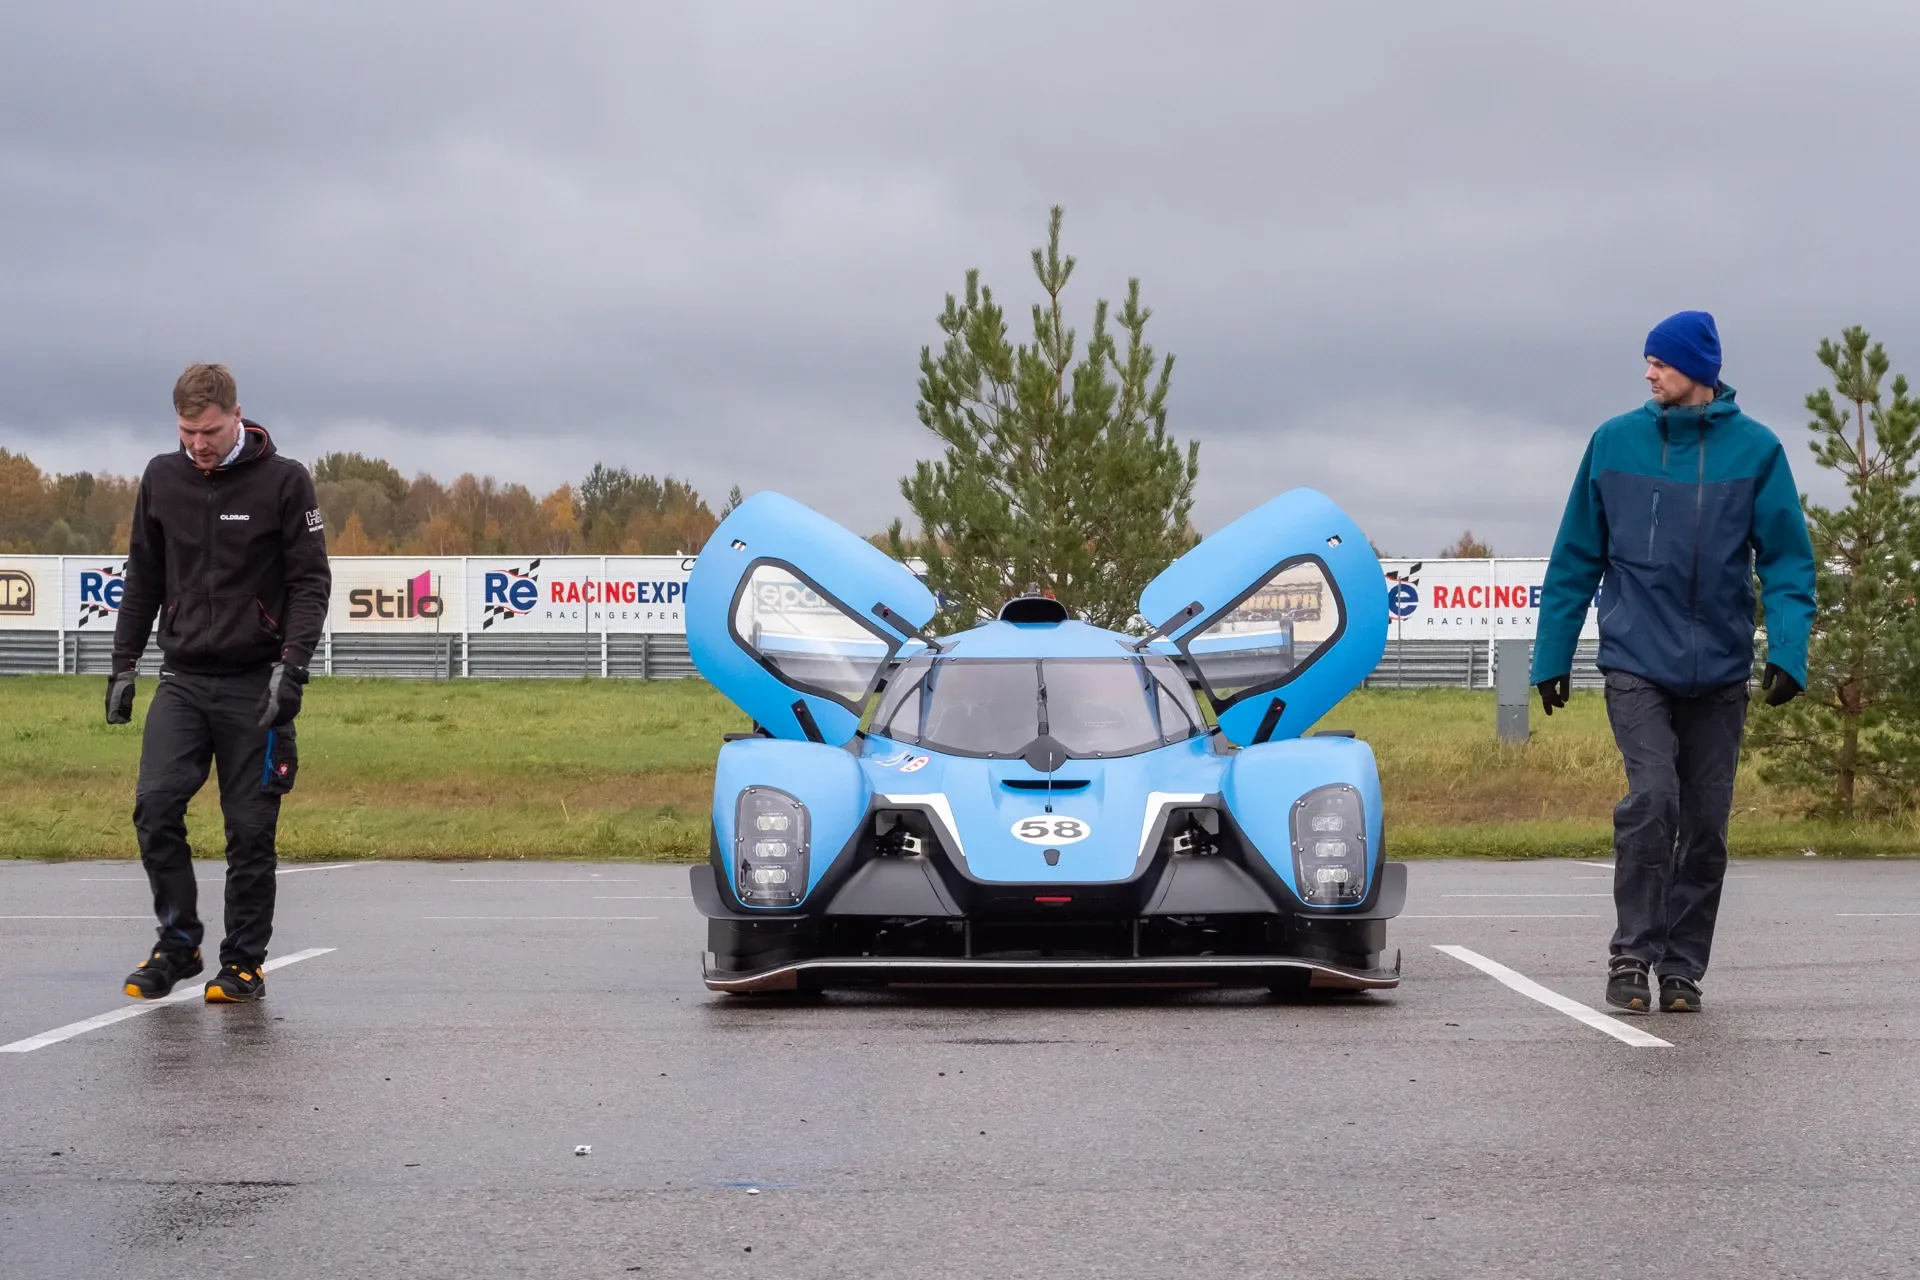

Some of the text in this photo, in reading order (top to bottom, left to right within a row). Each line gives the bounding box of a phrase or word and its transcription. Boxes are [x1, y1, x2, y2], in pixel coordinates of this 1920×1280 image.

[349, 578, 444, 619] Stilo
[485, 572, 538, 611] Re
[546, 611, 679, 620] RACNGEXPER
[1019, 820, 1083, 839] 58
